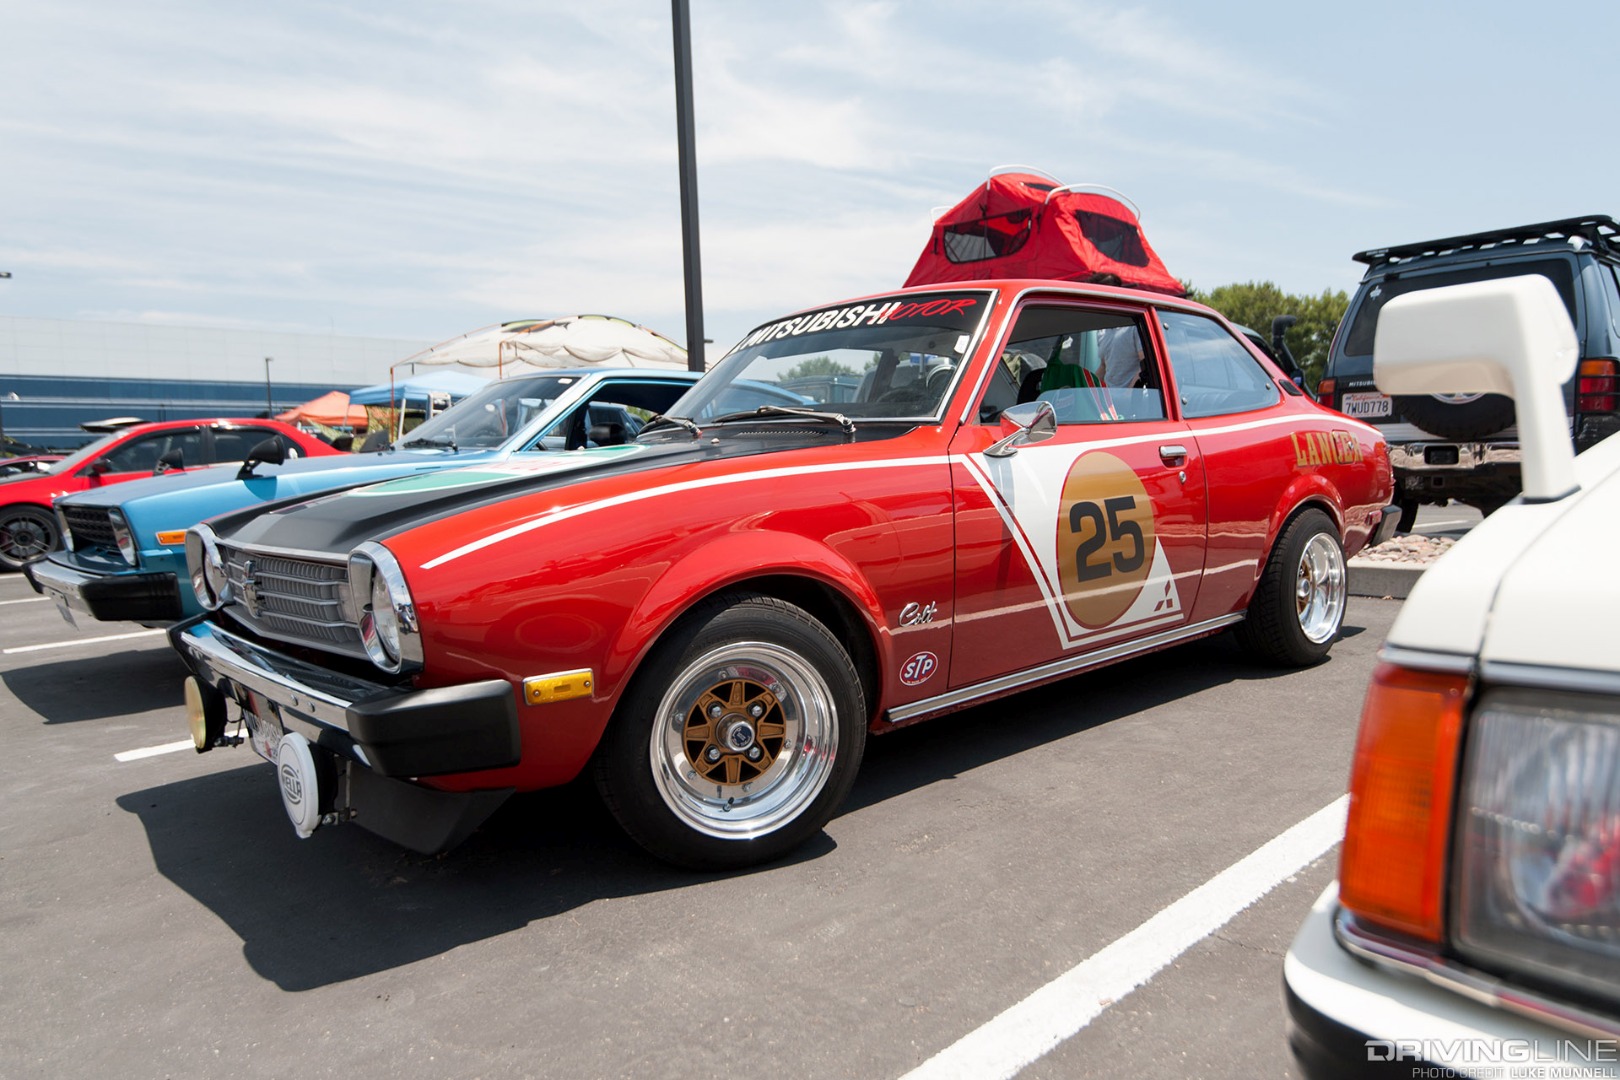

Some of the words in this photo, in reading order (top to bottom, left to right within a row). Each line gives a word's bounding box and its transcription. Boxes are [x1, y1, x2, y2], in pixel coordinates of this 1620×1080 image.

[738, 301, 902, 351] MITSUBISHI
[1345, 400, 1389, 414] 7WUD778
[1291, 431, 1363, 467] LANCER
[1069, 495, 1145, 583] 25
[899, 601, 938, 627] Colt
[904, 654, 933, 679] STP
